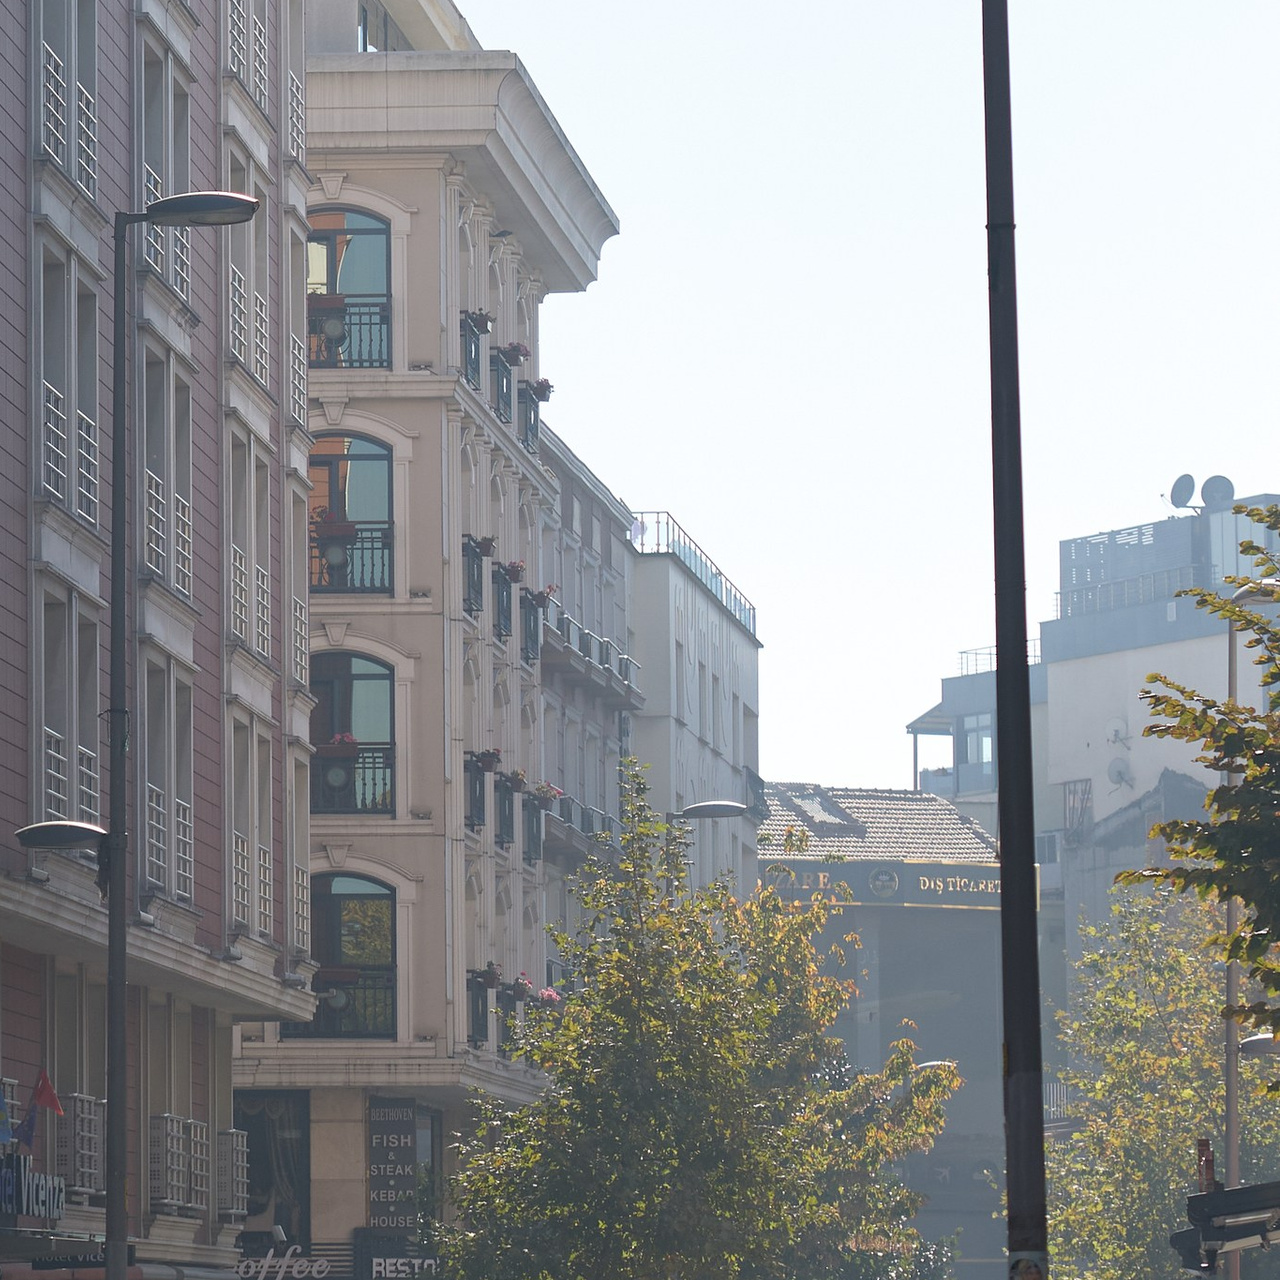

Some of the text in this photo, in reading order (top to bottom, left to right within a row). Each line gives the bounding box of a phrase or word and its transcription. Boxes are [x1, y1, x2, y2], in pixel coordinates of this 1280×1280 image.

[371, 1107, 413, 1121] BEETHOVEN
[373, 1134, 412, 1147] FISH
[388, 1151, 396, 1159] &
[370, 1164, 413, 1176] STEAK
[21, 1154, 65, 1220] Vicenza
[371, 1216, 414, 1227] HOUSE
